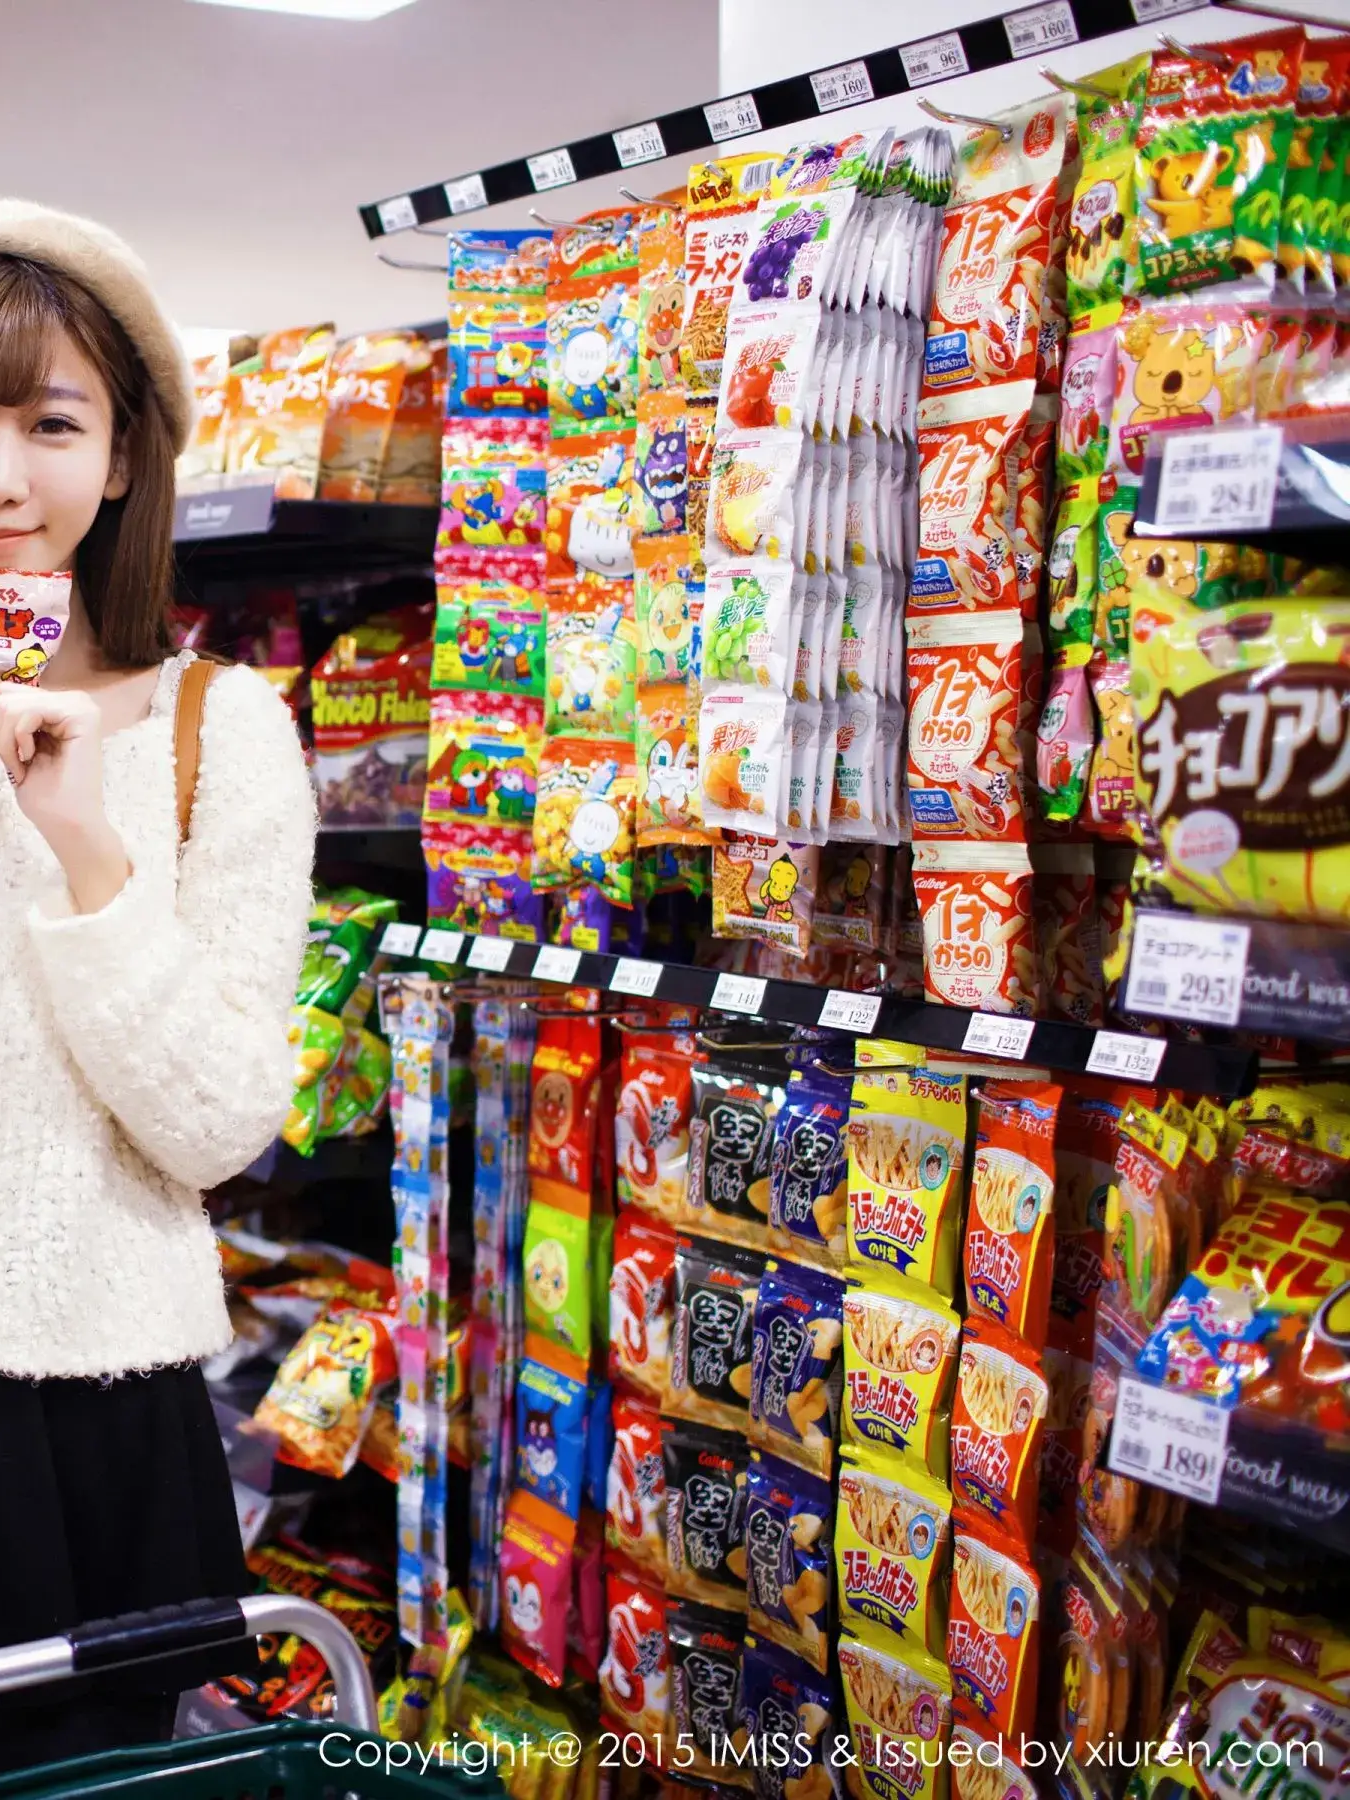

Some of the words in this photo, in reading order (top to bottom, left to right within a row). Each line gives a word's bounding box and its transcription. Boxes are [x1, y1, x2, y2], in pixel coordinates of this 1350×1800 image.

[1041, 20, 1065, 39] 160
[940, 51, 957, 67] 96
[842, 81, 863, 97] 160
[737, 113, 752, 126] 94
[685, 250, 743, 286] ラーメン
[948, 255, 996, 291] からの
[924, 528, 956, 542] えびせん
[714, 592, 771, 631] 果汁グミ
[908, 652, 942, 667] Calbee
[932, 662, 979, 718] 1才
[707, 718, 761, 755] 果汁グミ
[920, 718, 973, 747] からの
[929, 761, 959, 775] えびせん
[914, 876, 948, 891] Calbee
[938, 887, 988, 941] 1才
[933, 941, 992, 969] からの
[1143, 937, 1235, 963] チョコアソート
[949, 985, 982, 998] えびせん
[1179, 971, 1228, 1009] 295
[846, 1010, 870, 1026] 122
[996, 1034, 1021, 1052] 122
[1122, 1053, 1150, 1072] 132
[908, 1078, 962, 1105] プチサイズ
[848, 1190, 927, 1251] スティックポテト
[968, 1230, 1022, 1297] スティックポテト
[847, 1370, 919, 1433] スティックポテト
[951, 1424, 1011, 1492] スティックポテト
[1161, 1442, 1208, 1482] 189
[1287, 1472, 1349, 1515] way
[843, 1550, 918, 1616] スティックポテト
